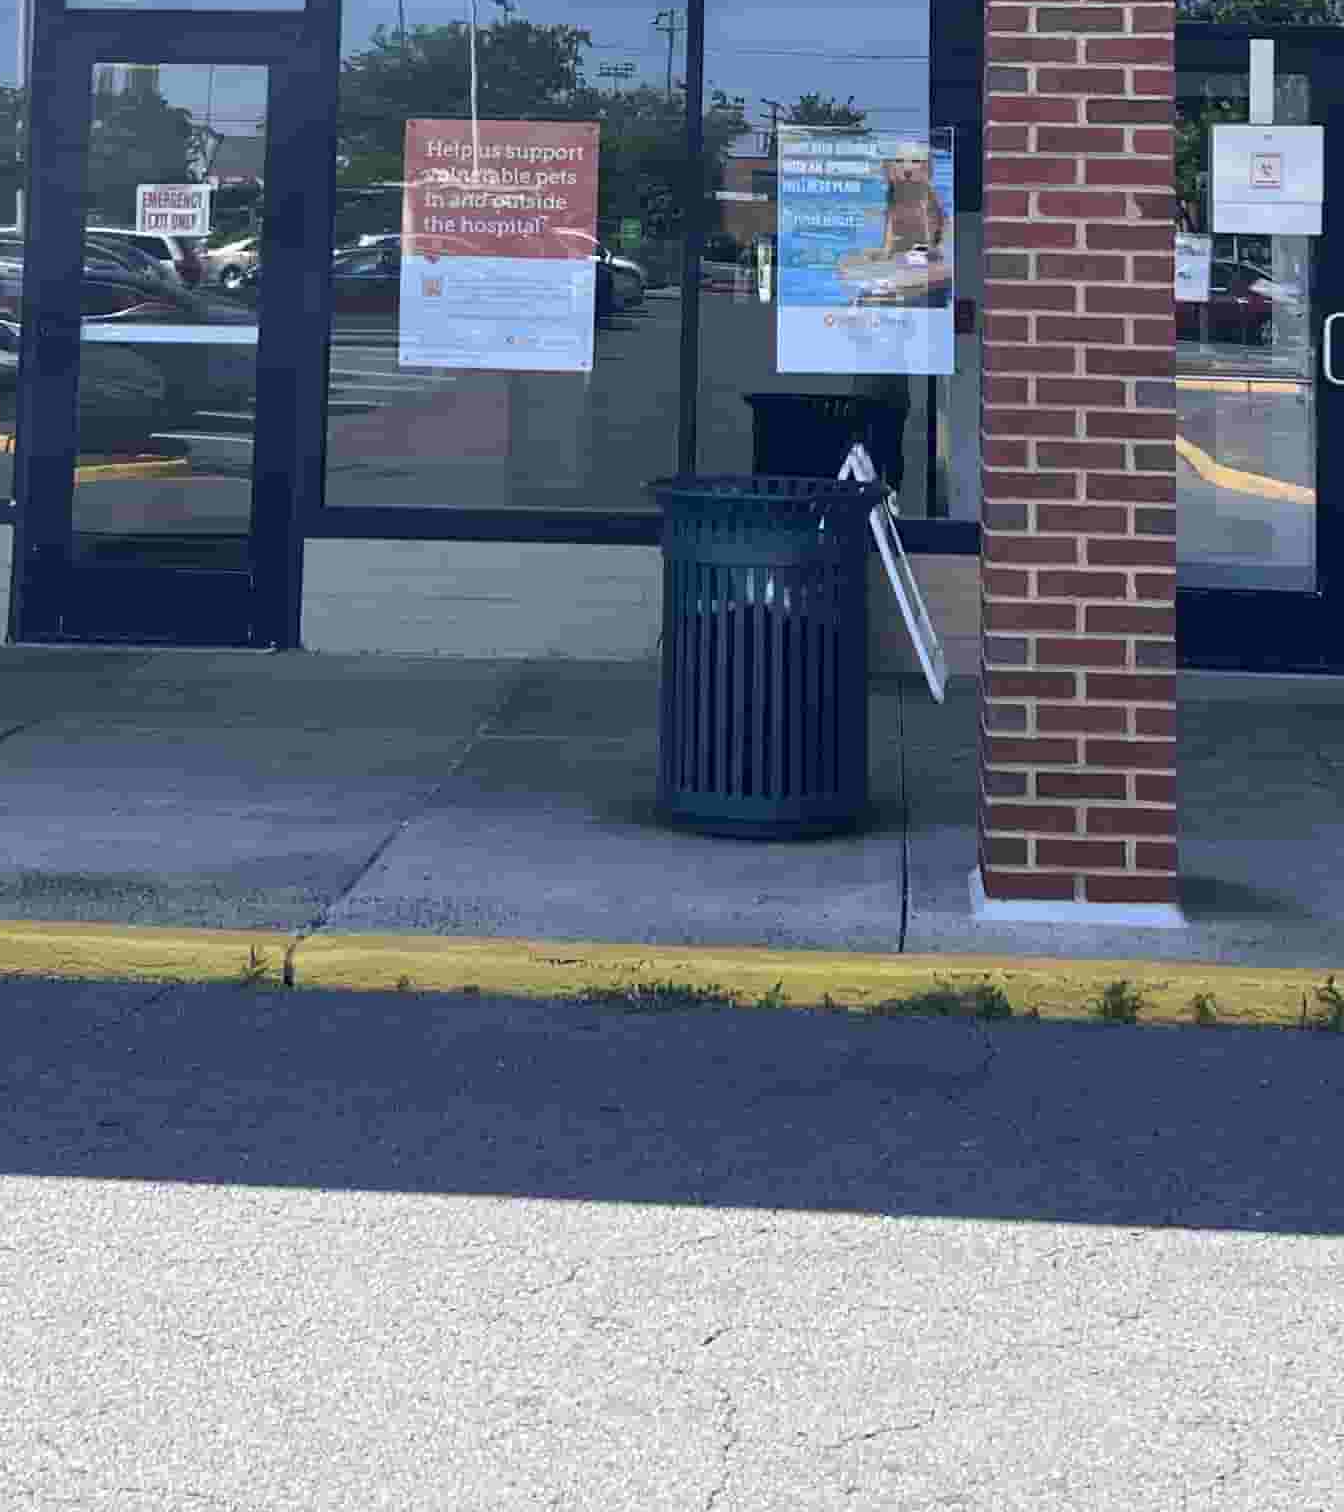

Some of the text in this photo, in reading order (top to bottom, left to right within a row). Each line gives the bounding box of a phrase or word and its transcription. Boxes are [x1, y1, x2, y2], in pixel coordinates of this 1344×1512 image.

[425, 140, 584, 164] Help us support
[535, 170, 577, 189] pets
[424, 216, 456, 233] the
